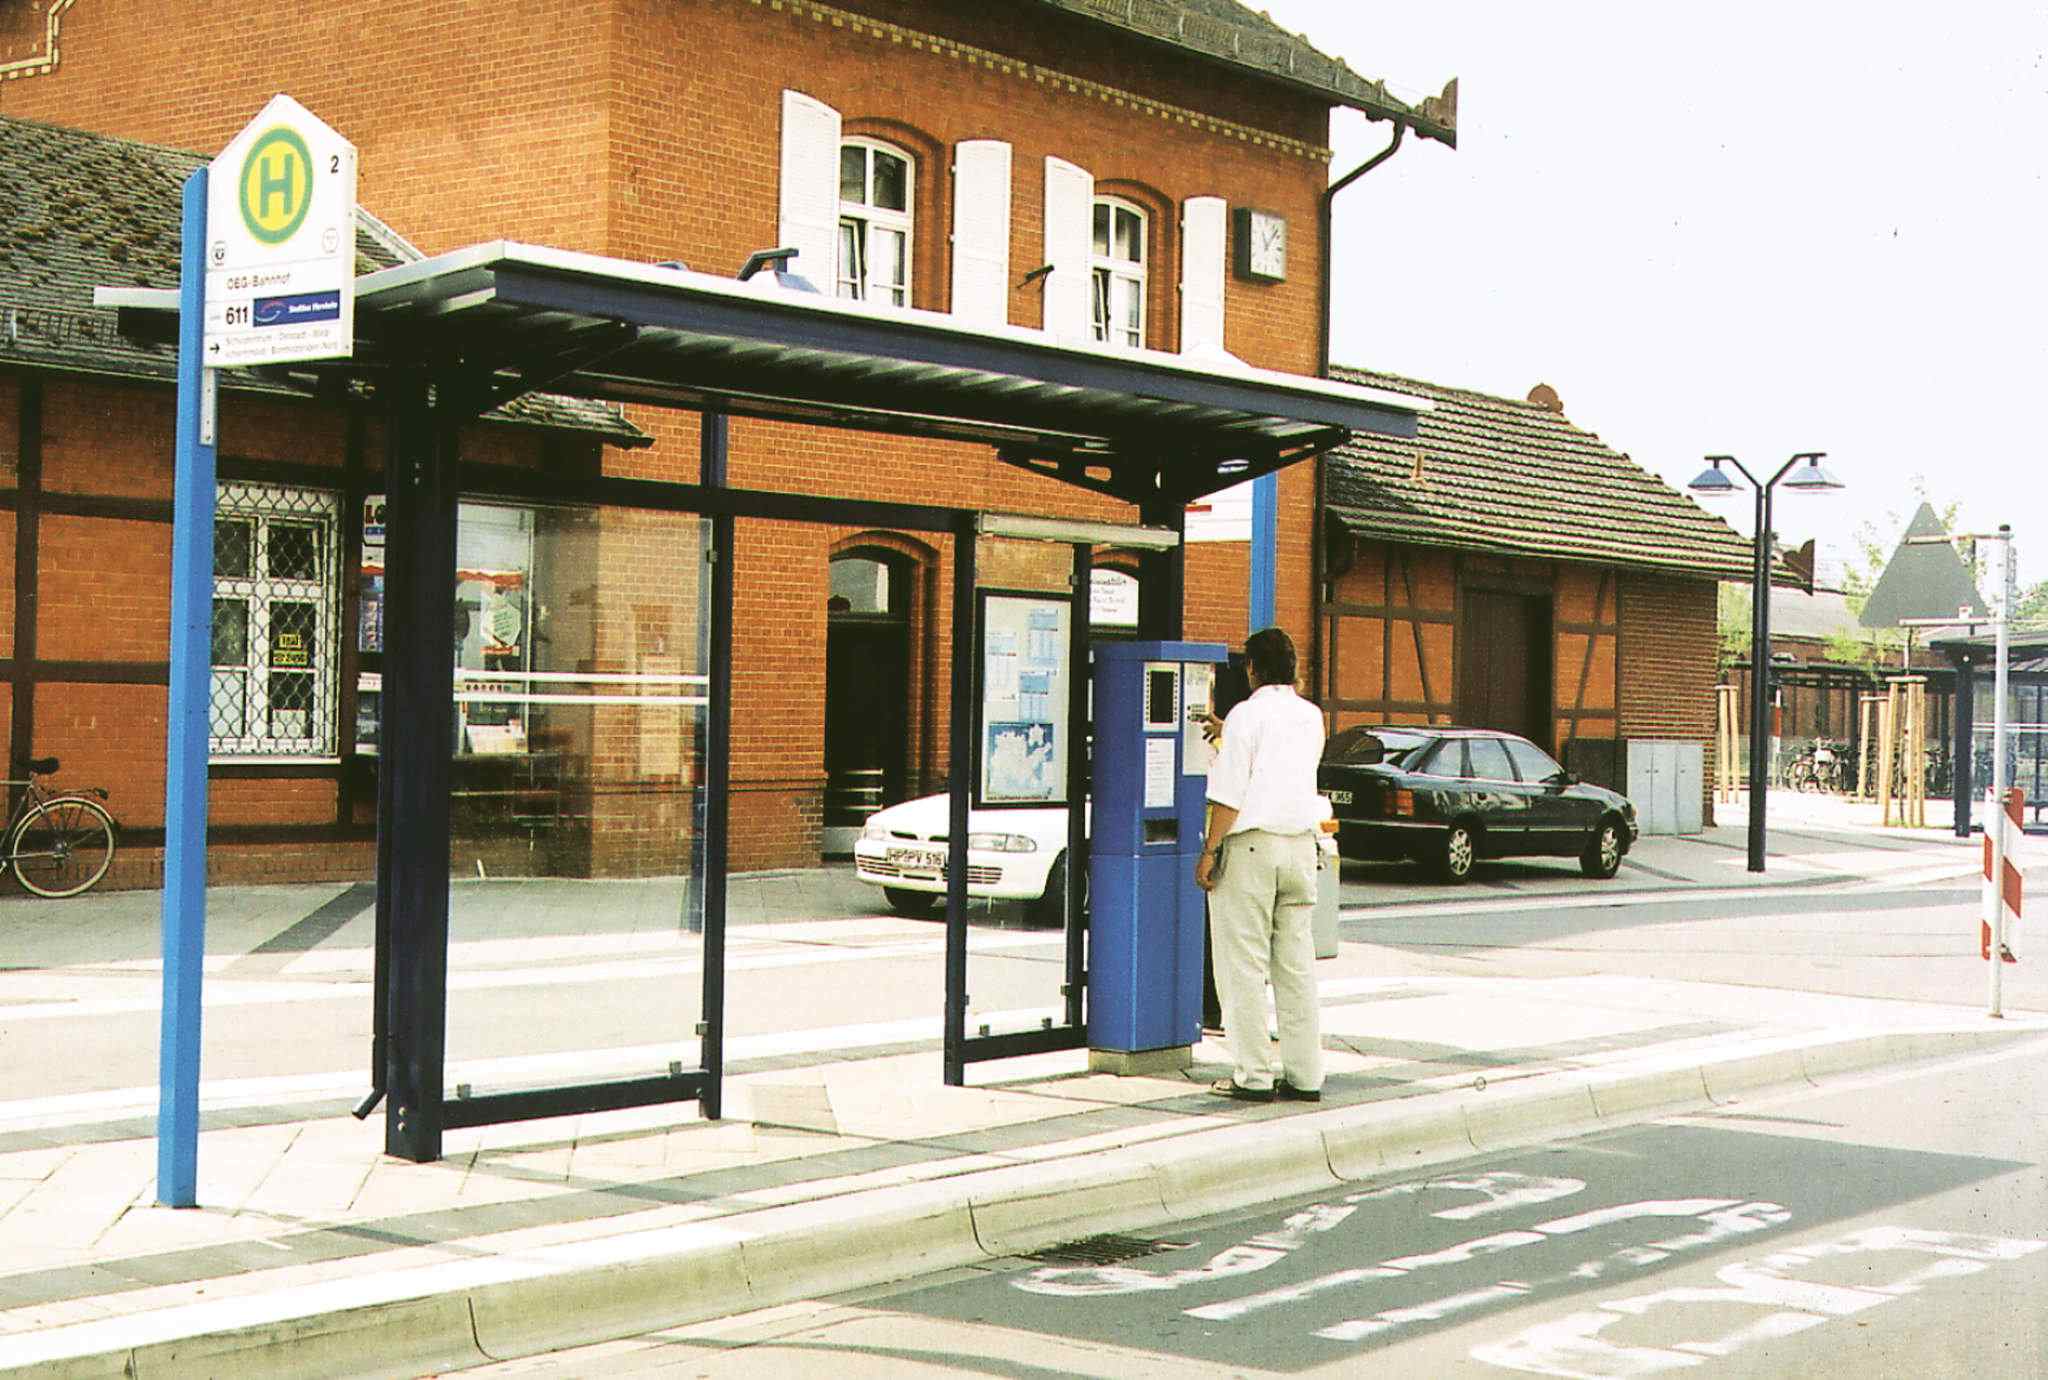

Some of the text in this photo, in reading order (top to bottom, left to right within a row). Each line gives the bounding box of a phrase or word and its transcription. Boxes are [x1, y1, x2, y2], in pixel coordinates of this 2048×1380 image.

[330, 155, 340, 174] 2
[260, 153, 293, 219] H
[225, 305, 249, 325] 611
